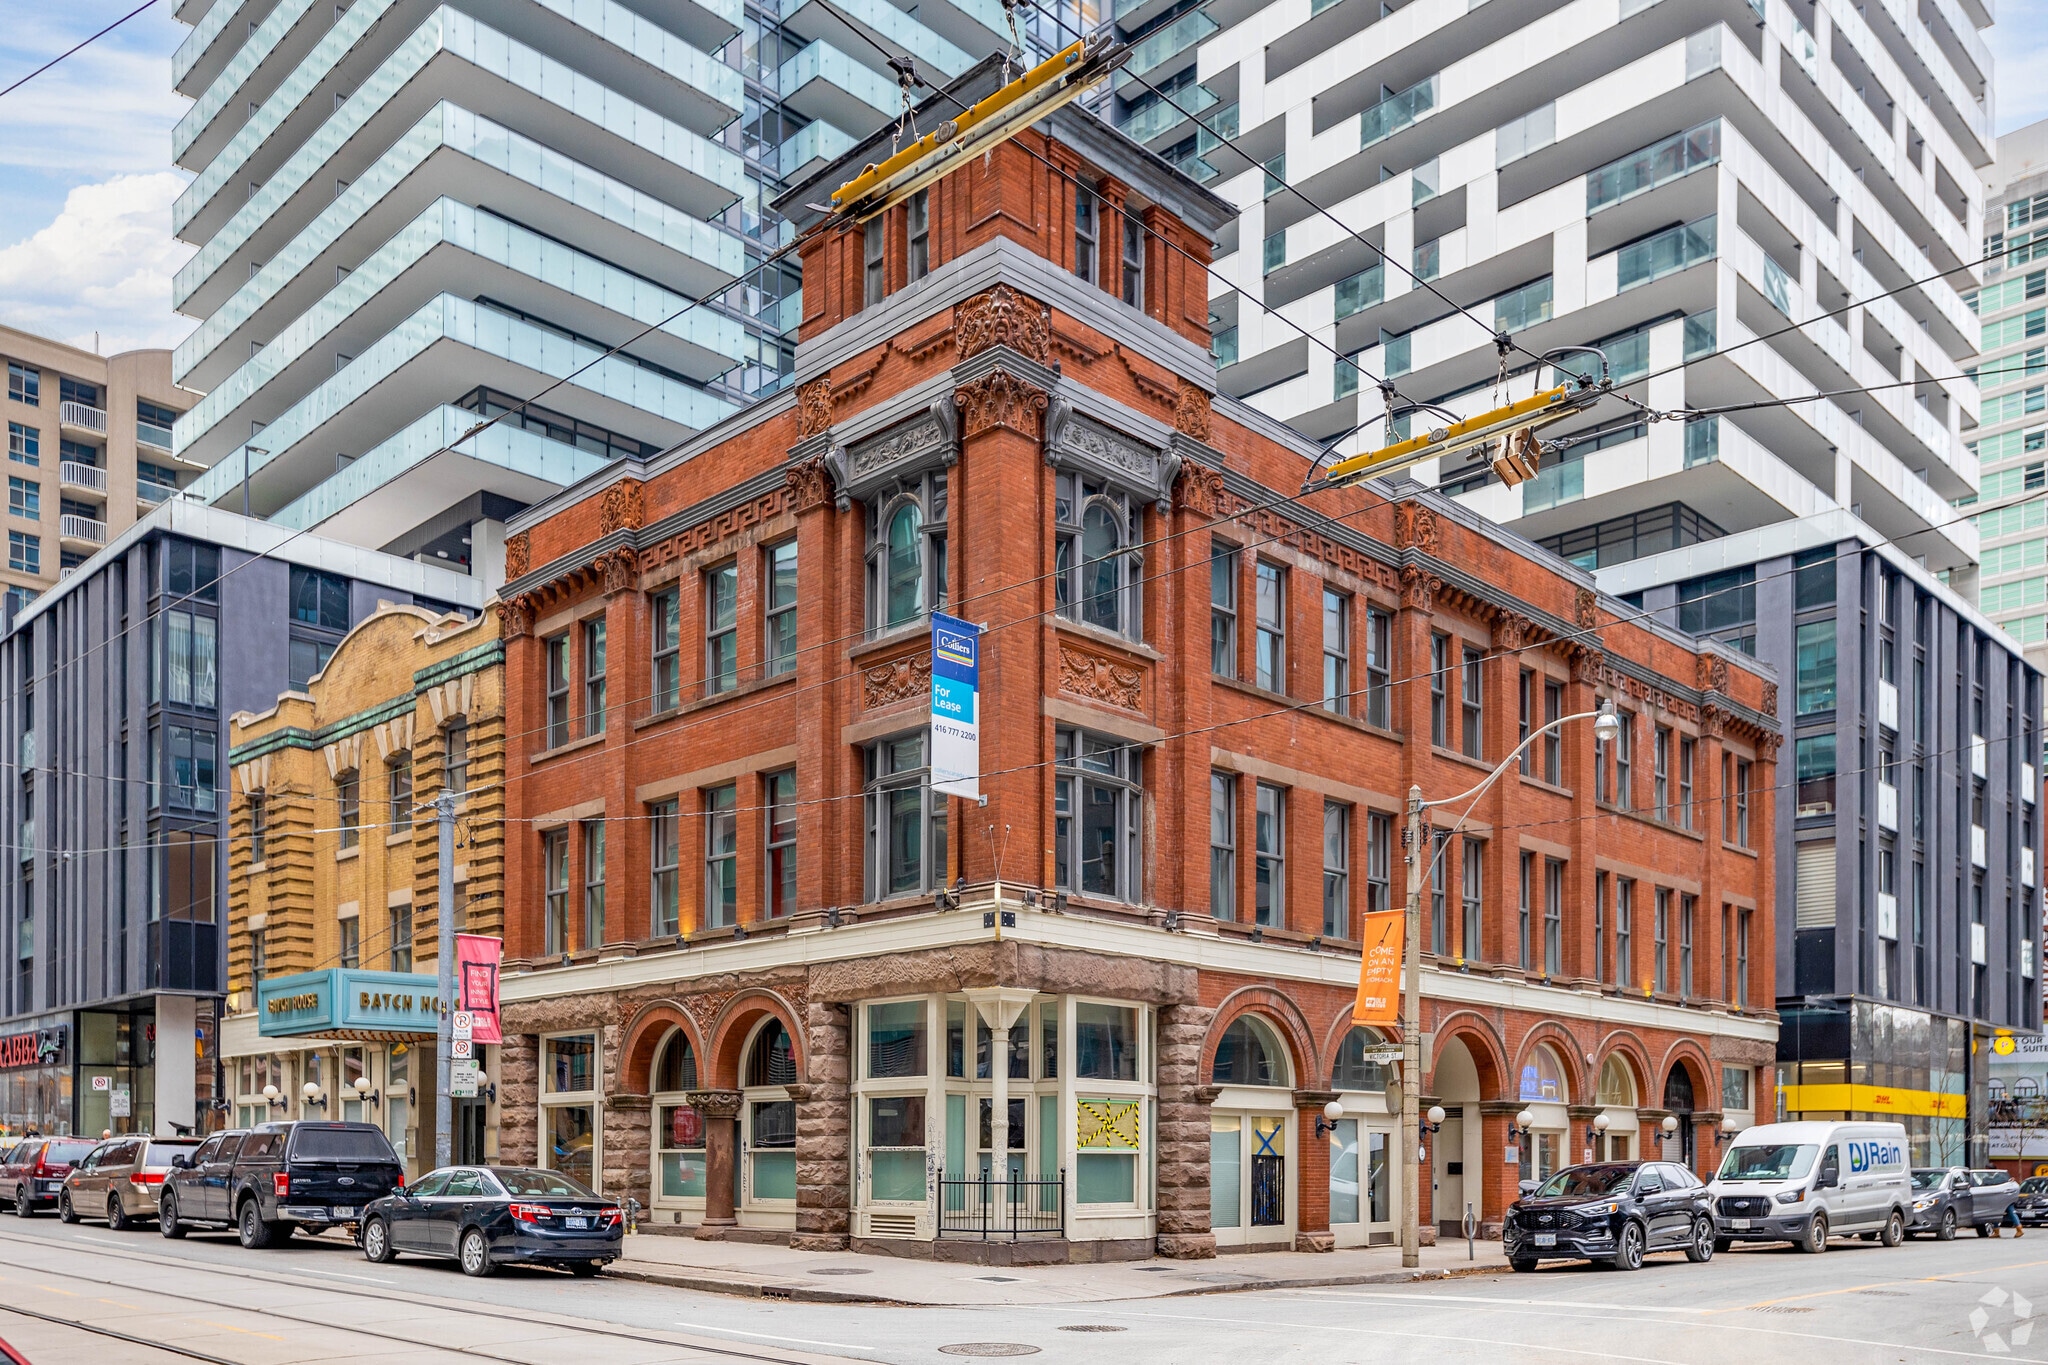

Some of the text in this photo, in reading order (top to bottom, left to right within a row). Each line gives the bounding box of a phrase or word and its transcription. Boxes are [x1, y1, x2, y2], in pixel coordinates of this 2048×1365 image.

[941, 636, 970, 654] Colliers
[935, 684, 951, 698] For
[935, 696, 962, 713] Lease
[934, 724, 976, 742] 416 777 2200
[1369, 946, 1395, 958] COME
[1368, 957, 1395, 967] ON AN
[470, 970, 489, 978] FIND
[1367, 967, 1393, 976] EMPTY
[268, 992, 318, 1013] BATCH HOUSE
[359, 991, 412, 1010] BATCH
[2021, 1036, 2043, 1044] OUR
